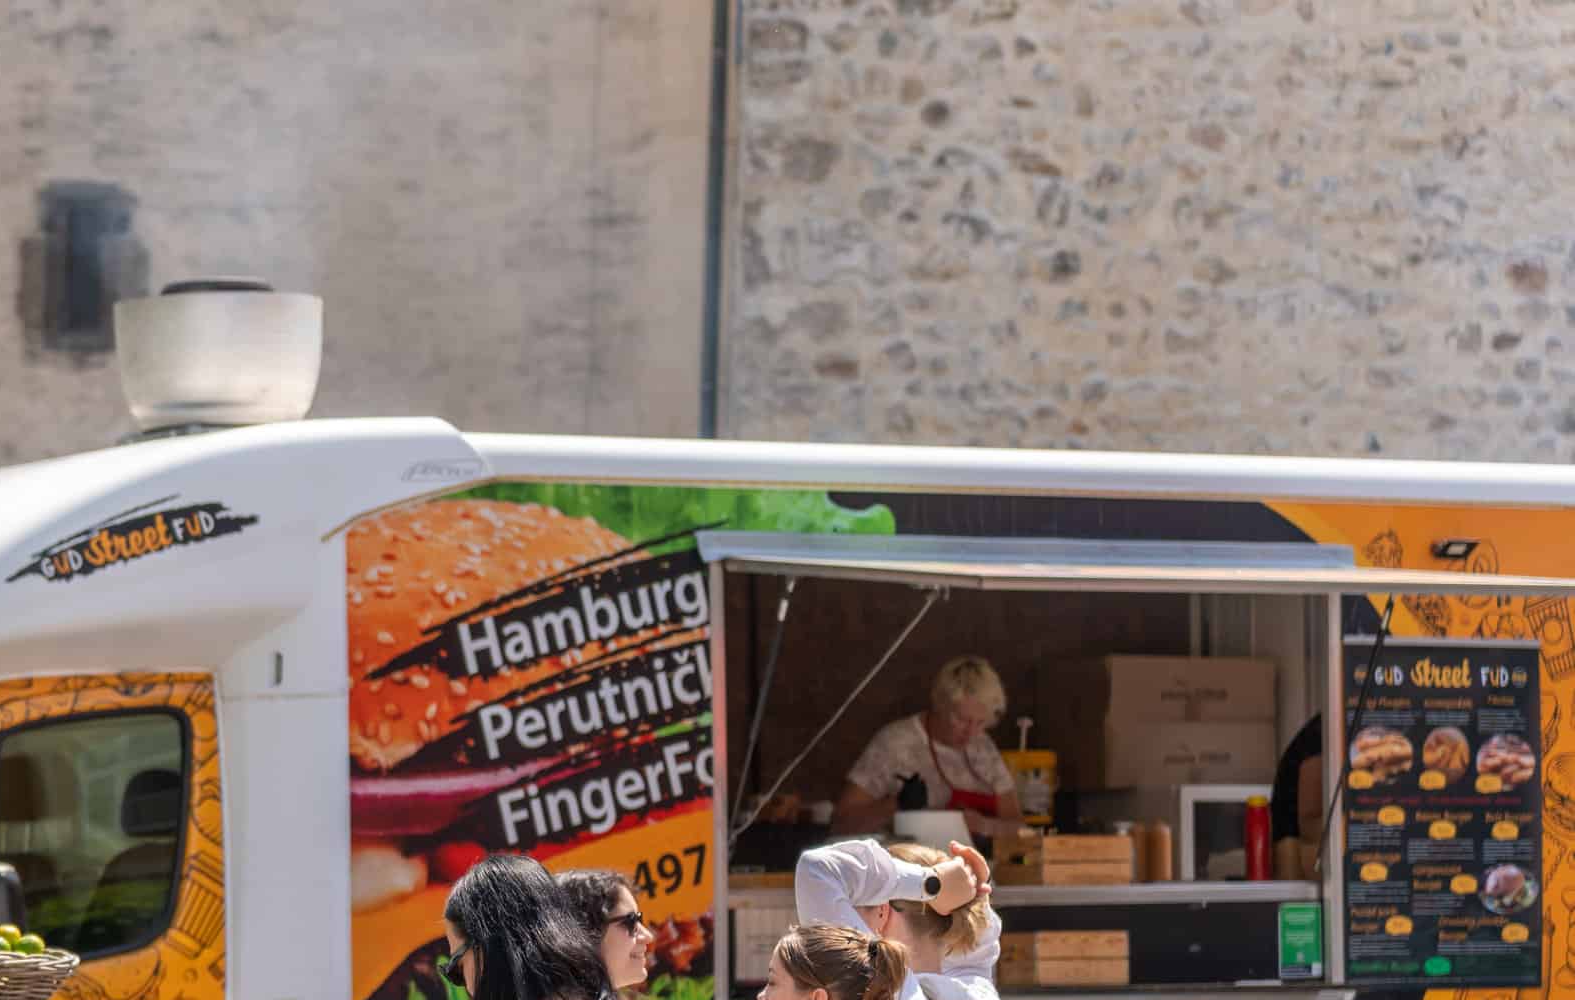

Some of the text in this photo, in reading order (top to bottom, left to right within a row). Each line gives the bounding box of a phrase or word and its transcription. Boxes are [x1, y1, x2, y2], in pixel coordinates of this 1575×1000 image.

[39, 510, 216, 578] GUD Street FUD
[457, 569, 709, 675] Hamburg
[1374, 656, 1510, 689] GUD Street FUD
[632, 843, 708, 900] 497
